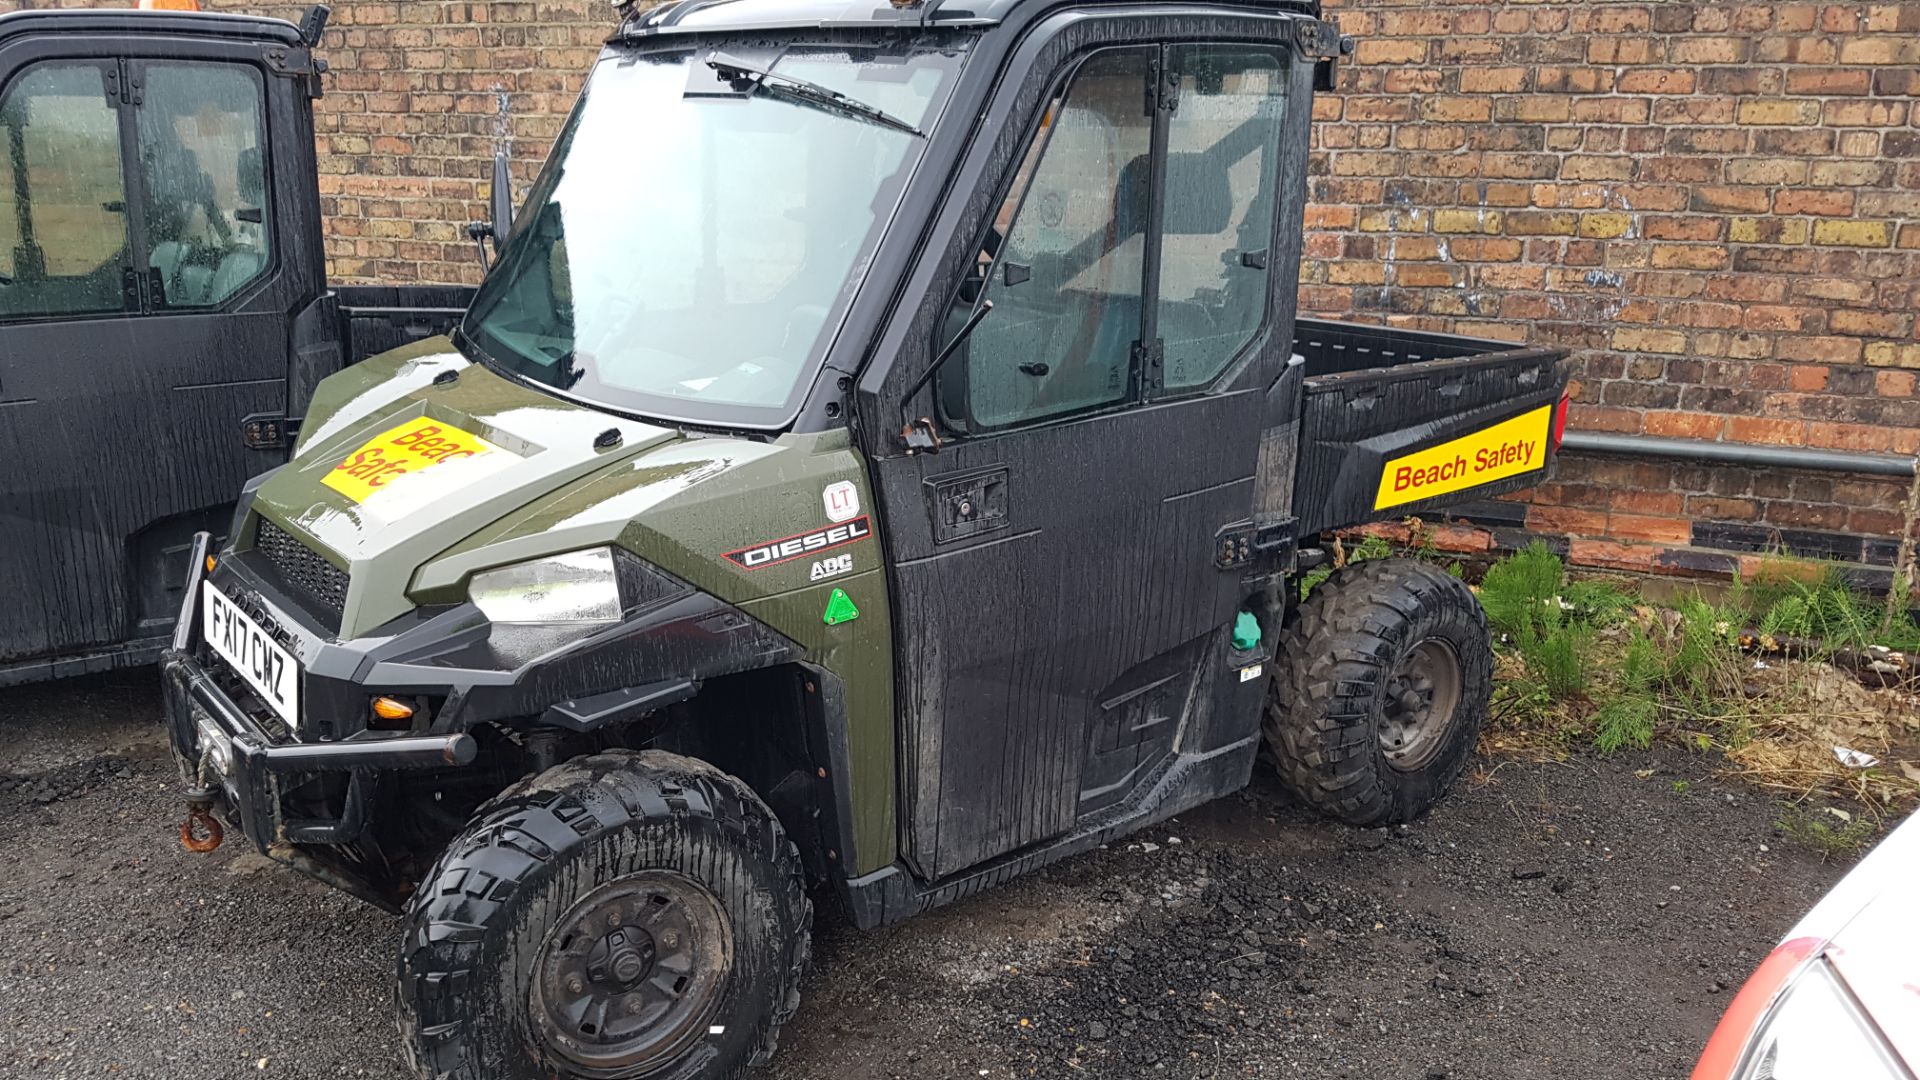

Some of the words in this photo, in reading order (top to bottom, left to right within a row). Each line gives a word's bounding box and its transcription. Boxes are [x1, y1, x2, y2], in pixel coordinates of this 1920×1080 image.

[391, 426, 475, 464] Beac
[336, 448, 407, 486] Safe
[1394, 455, 1466, 492] Beach
[1474, 439, 1536, 473] Safety
[831, 489, 850, 509] LT
[744, 524, 868, 567] DIESEL
[213, 594, 247, 666] FX17
[252, 631, 284, 706] CMZ
